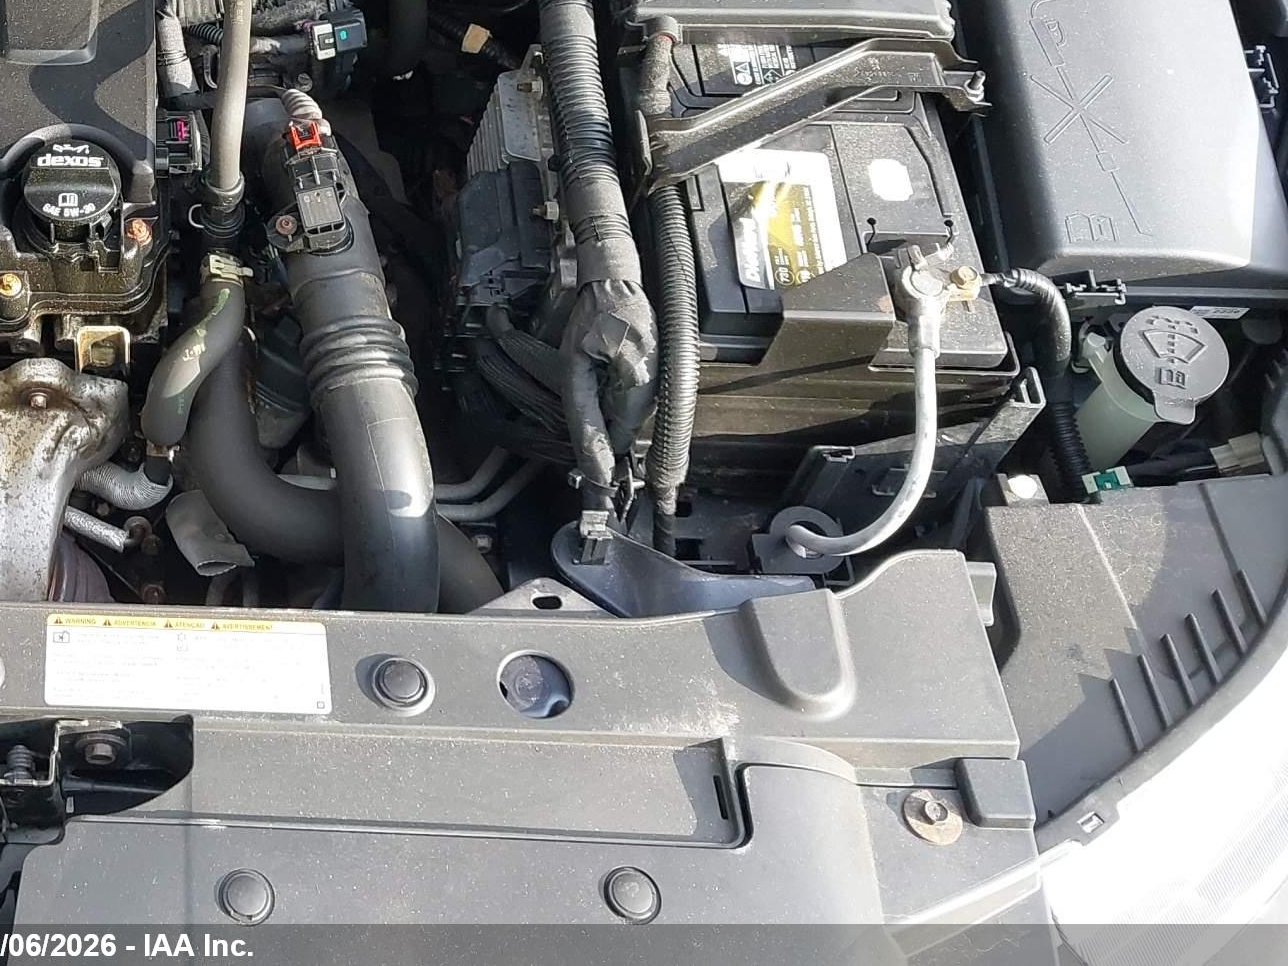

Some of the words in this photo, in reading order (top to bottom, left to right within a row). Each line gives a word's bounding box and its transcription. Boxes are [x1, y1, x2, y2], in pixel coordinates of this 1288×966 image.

[36, 153, 103, 168] dexos
[42, 202, 62, 217] SAE
[63, 202, 96, 218] 5W-30
[778, 267, 790, 283] 730
[65, 617, 97, 625] WARNING
